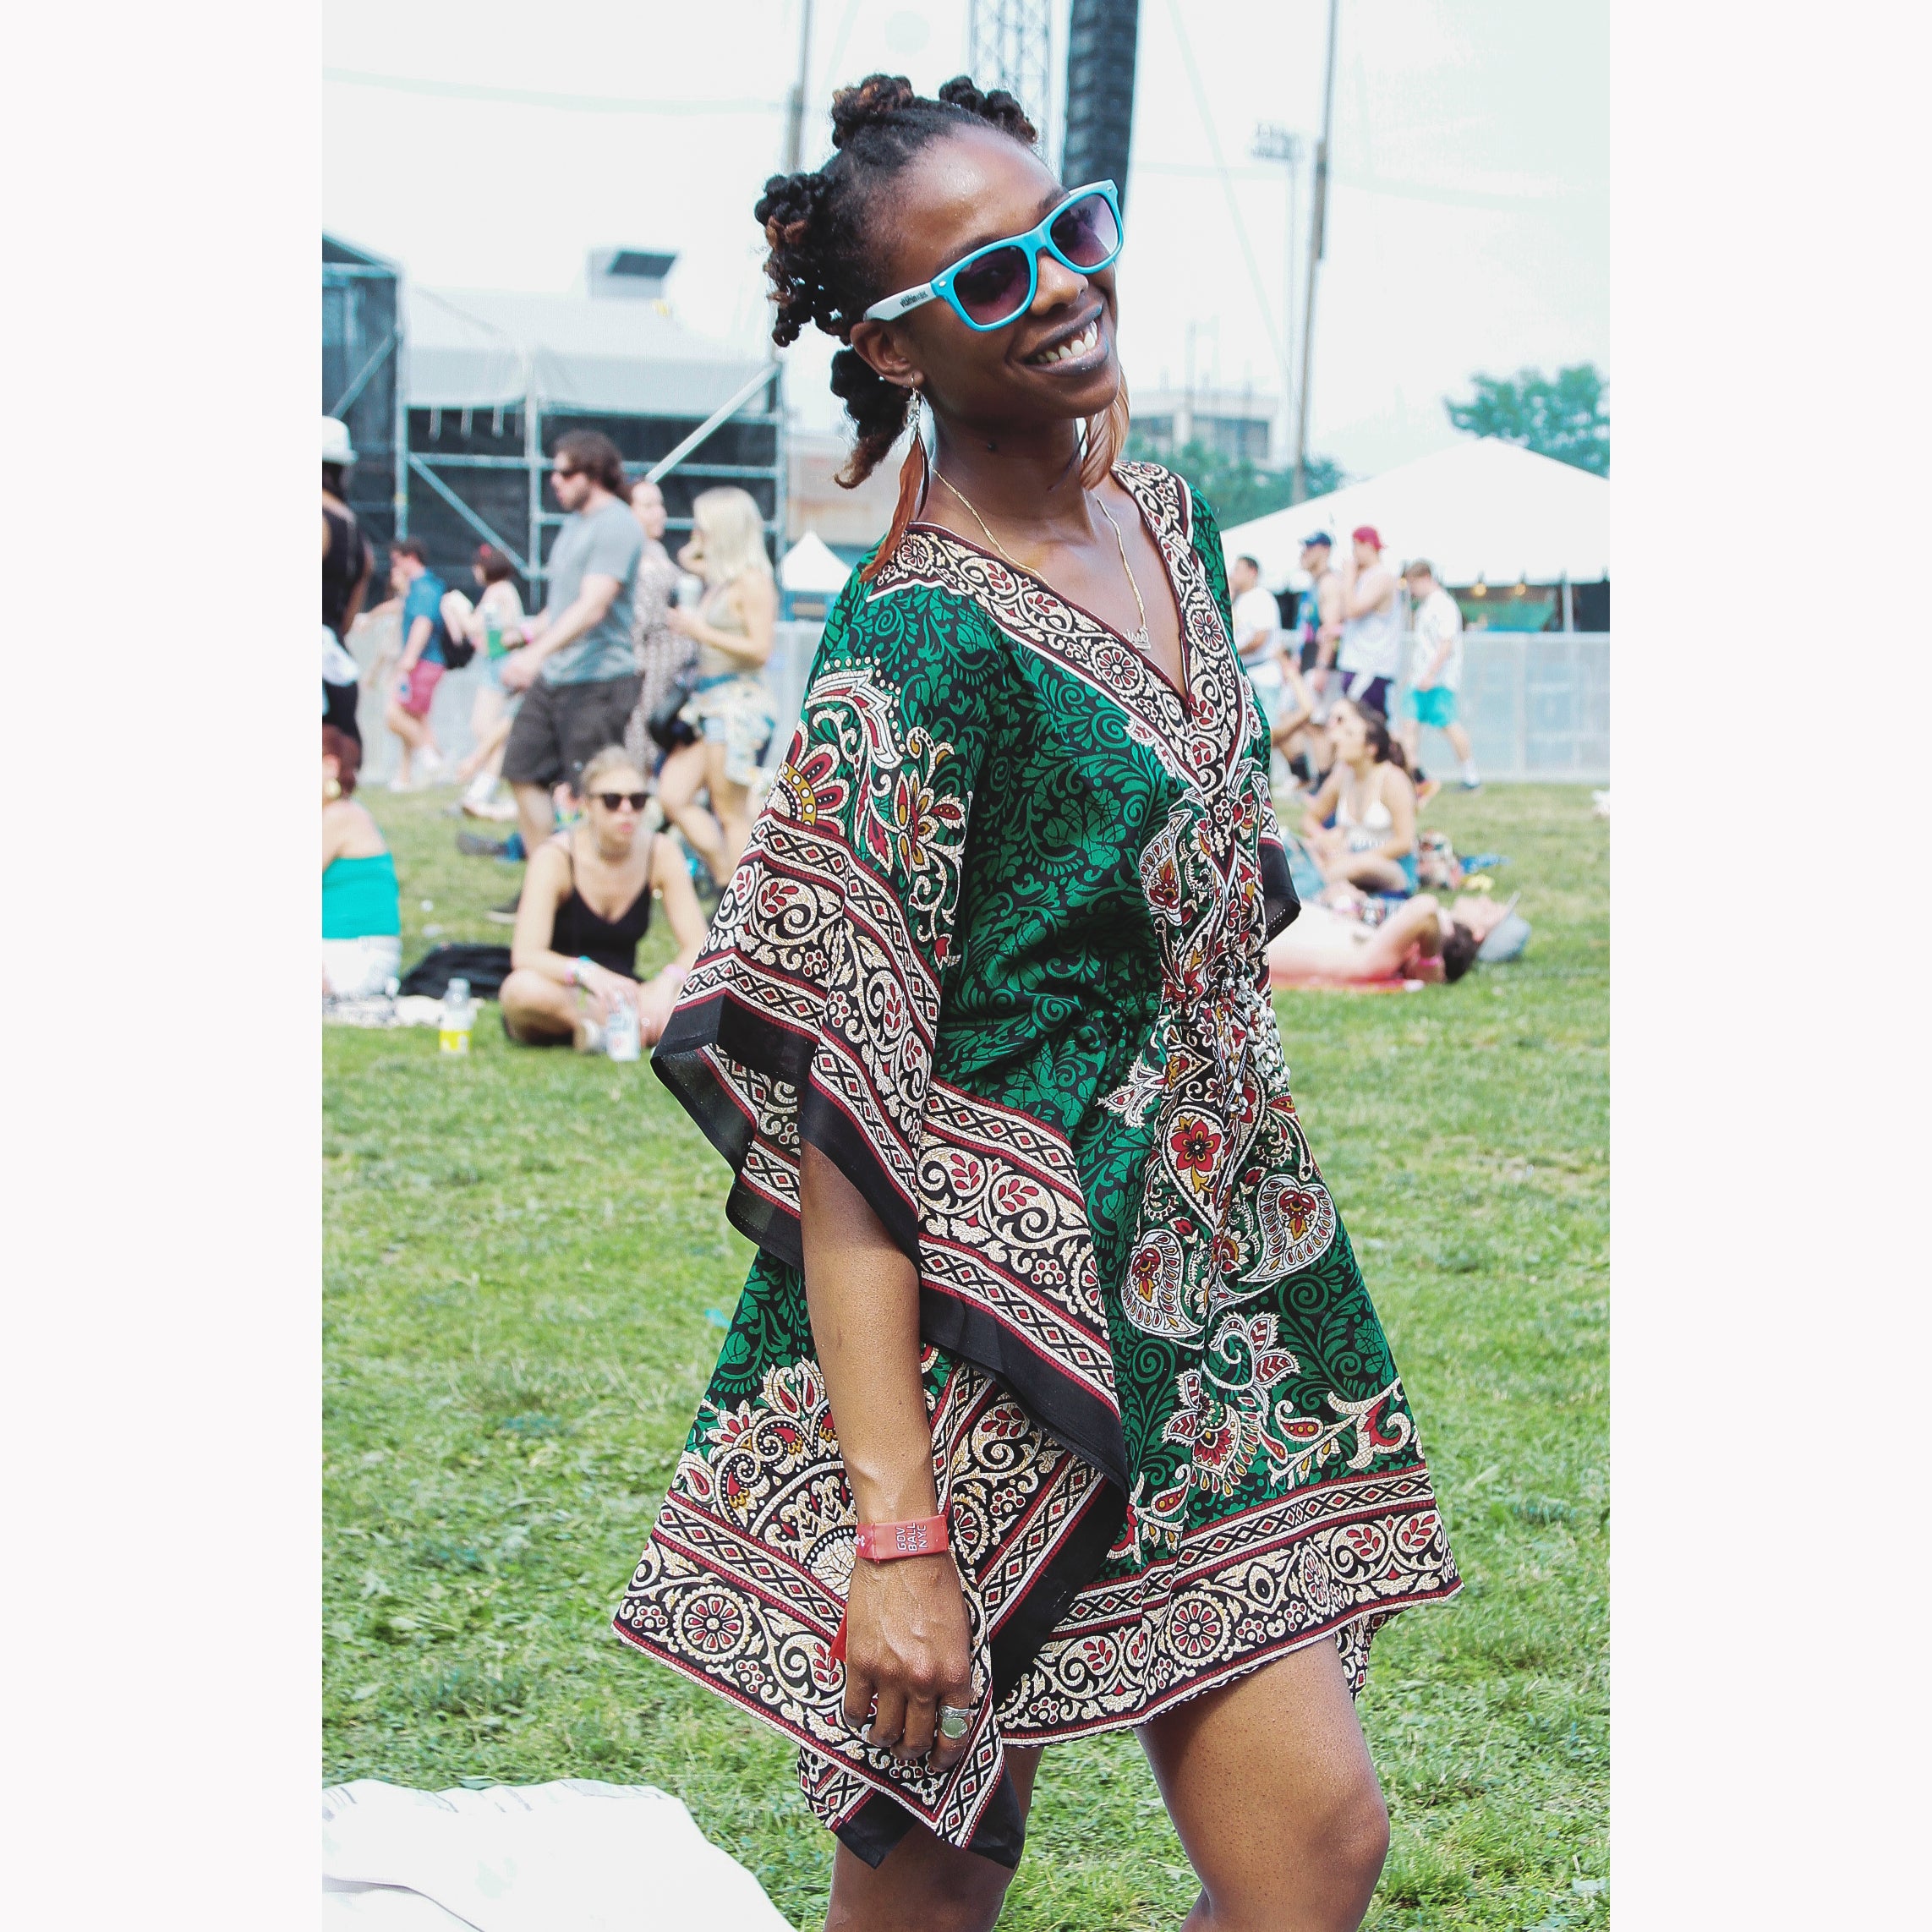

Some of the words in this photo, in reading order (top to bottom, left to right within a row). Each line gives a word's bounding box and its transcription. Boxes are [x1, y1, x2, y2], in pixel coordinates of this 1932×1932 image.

[896, 1527, 907, 1551] GOV
[906, 1522, 917, 1552] BALL
[917, 1524, 928, 1548] NYC
